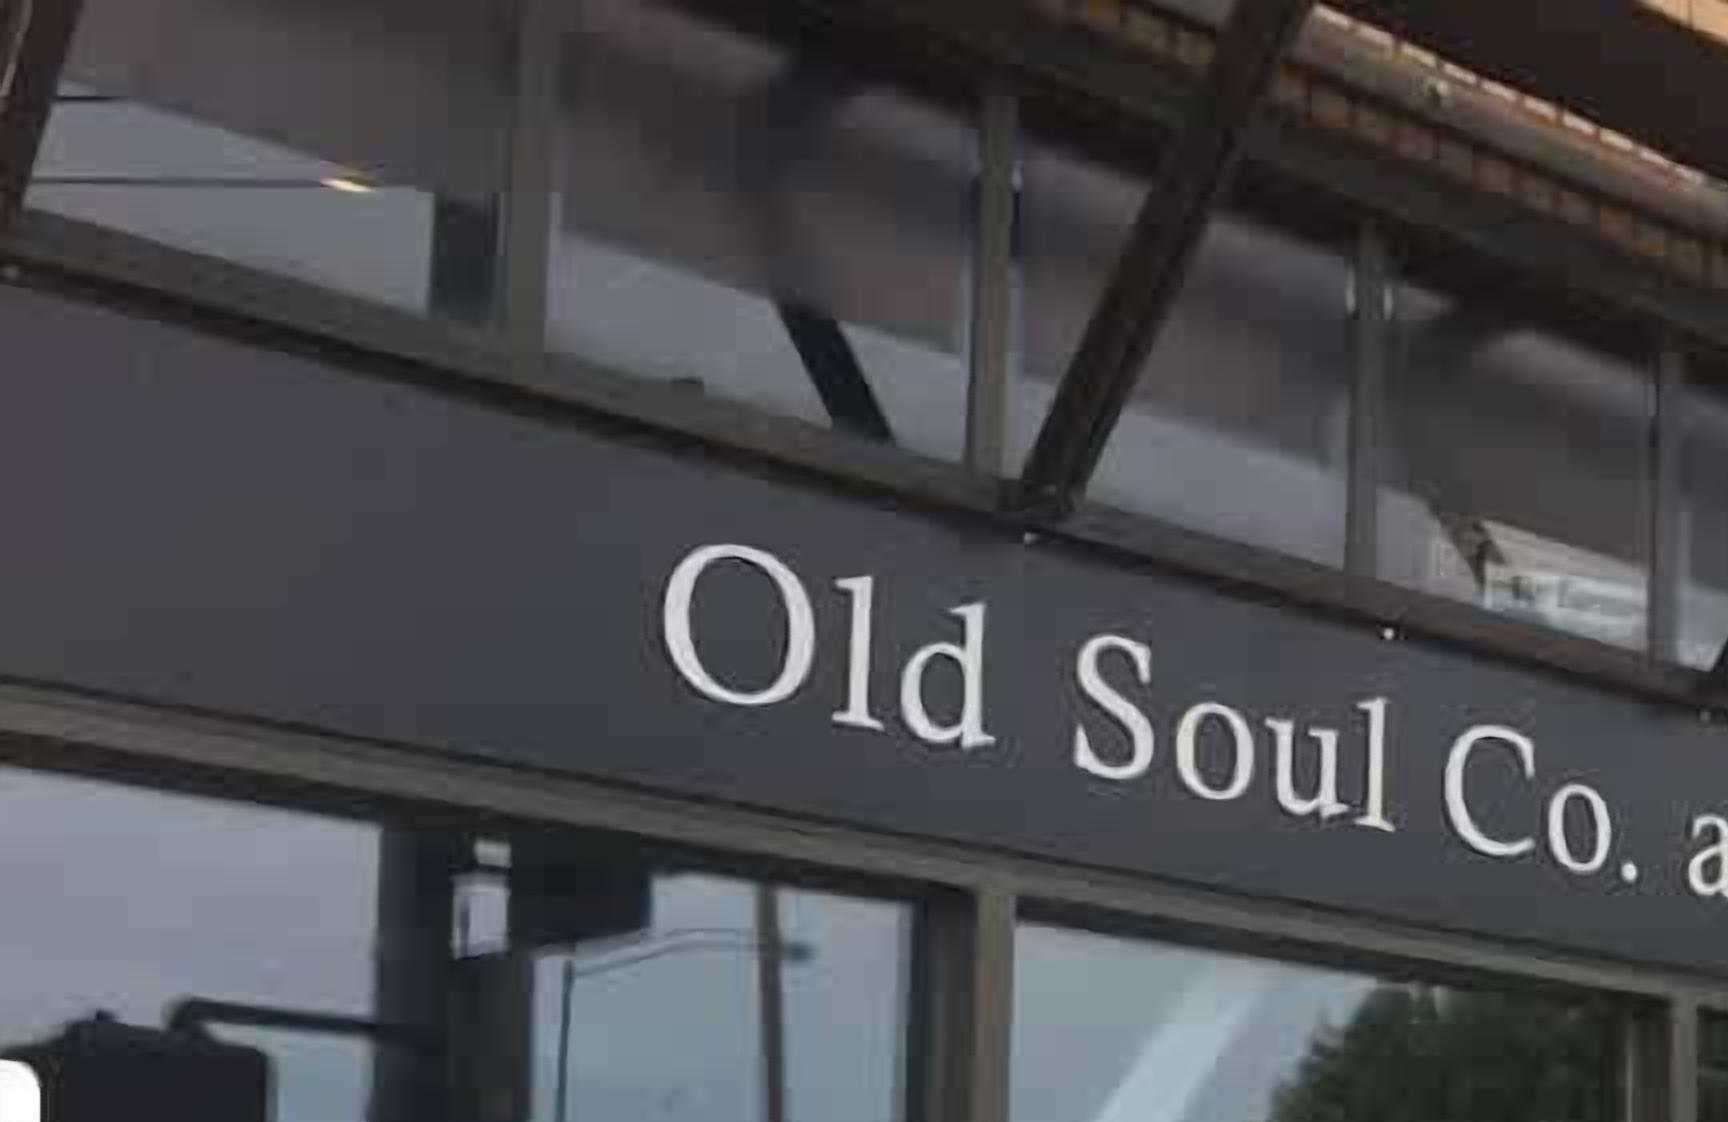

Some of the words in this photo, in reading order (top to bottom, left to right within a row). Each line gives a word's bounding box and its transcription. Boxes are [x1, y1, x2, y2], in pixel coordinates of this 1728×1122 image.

[664, 544, 996, 748] Old
[1074, 634, 1396, 832] Soul
[1444, 724, 1637, 881] Co.
